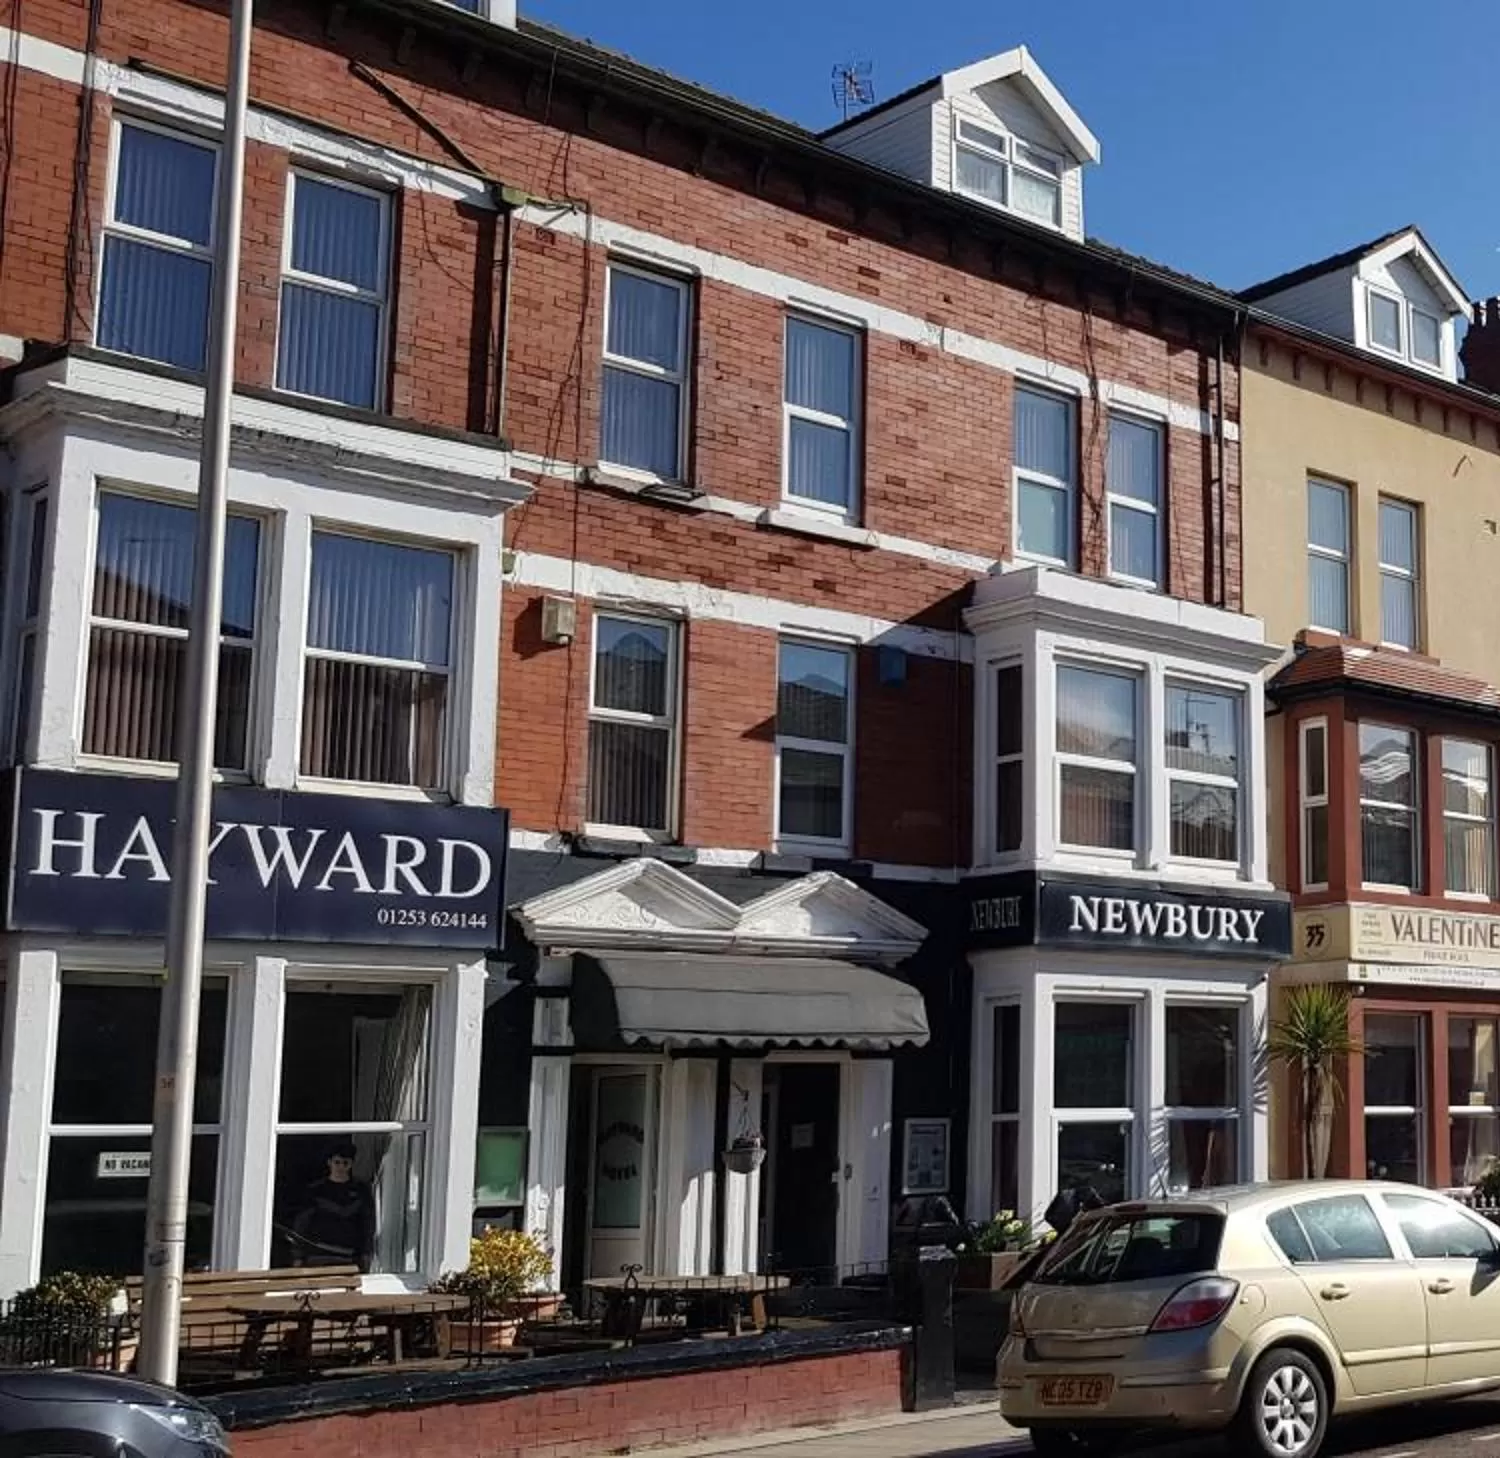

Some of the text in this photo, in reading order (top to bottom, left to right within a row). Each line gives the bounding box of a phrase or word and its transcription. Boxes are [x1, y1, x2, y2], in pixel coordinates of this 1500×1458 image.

[377, 907, 488, 929] 01253 624144
[1068, 894, 1265, 943] NEWBURY
[1305, 923, 1326, 949] 35
[104, 1159, 117, 1169] NO
